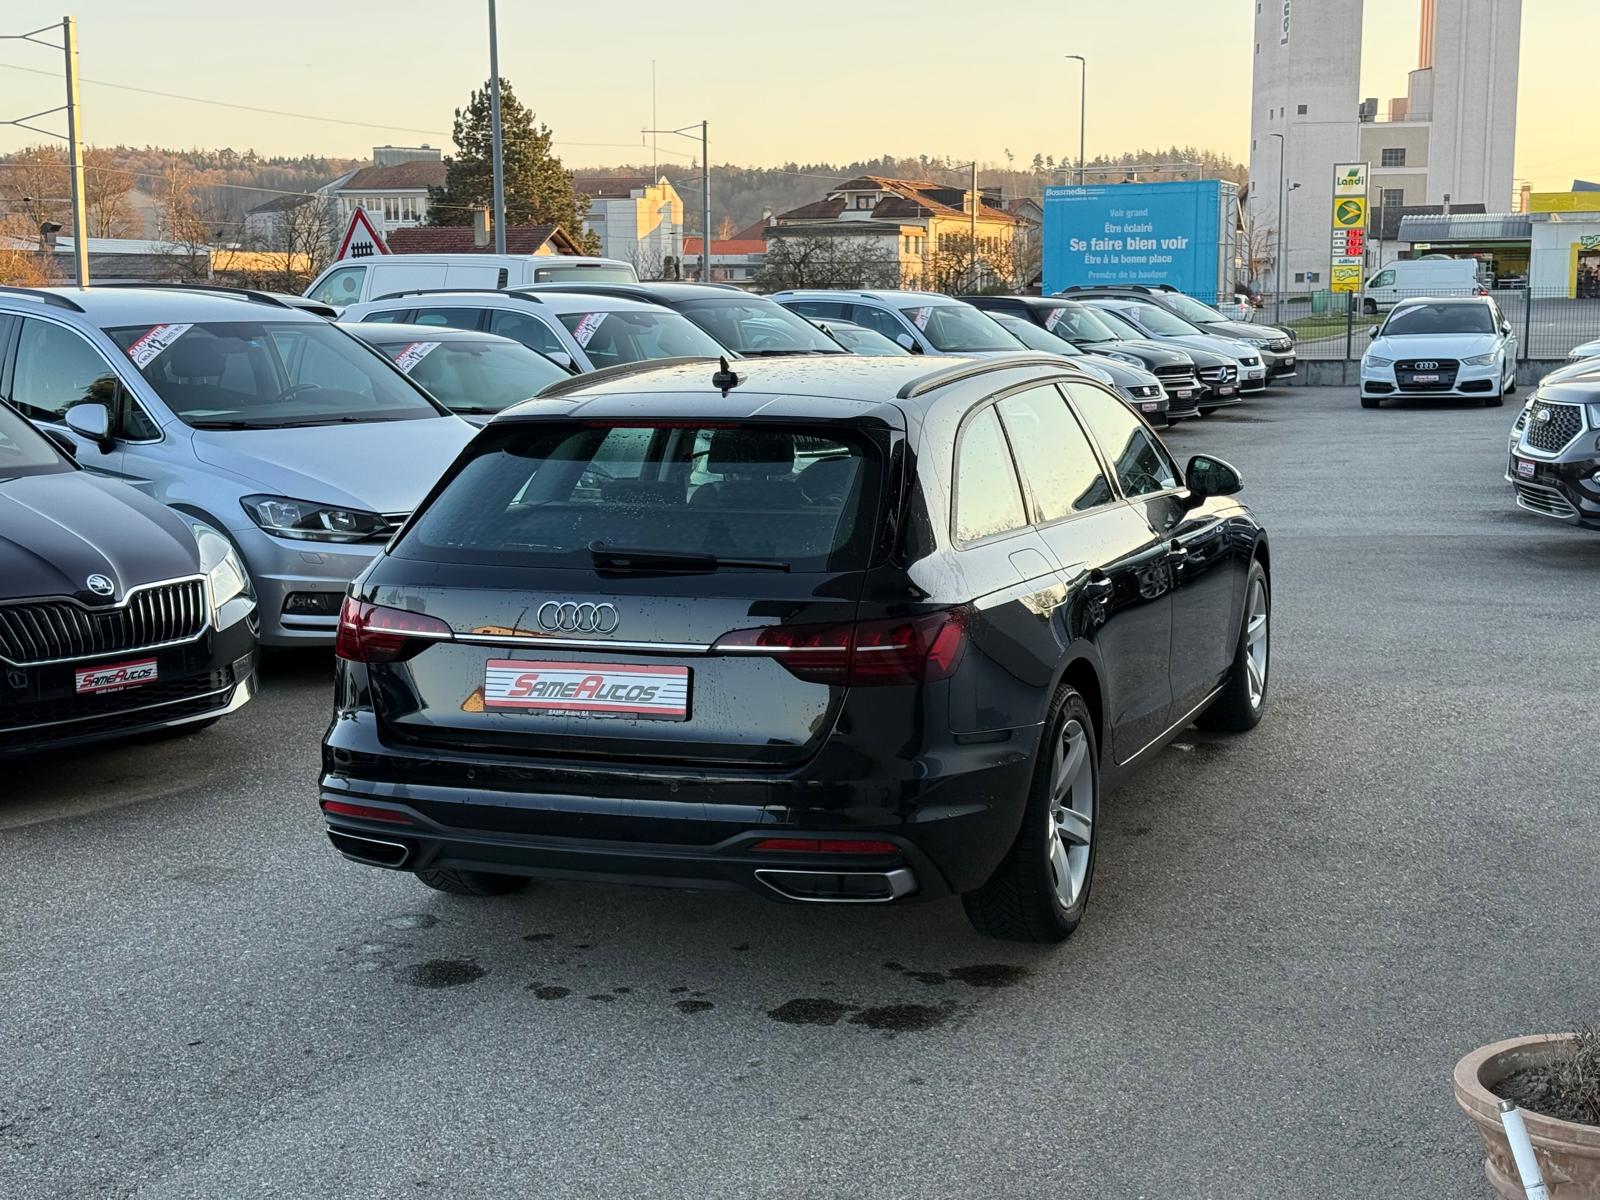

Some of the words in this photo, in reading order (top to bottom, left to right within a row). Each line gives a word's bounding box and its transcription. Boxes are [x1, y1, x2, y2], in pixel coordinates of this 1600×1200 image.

[1281, 0, 1290, 45] Lan
[1336, 176, 1364, 186] Landi
[1109, 209, 1124, 217] Voir
[1126, 208, 1148, 218] grand
[1104, 222, 1121, 233] Être
[1124, 222, 1152, 233] éclairé
[1069, 238, 1087, 251] Se
[1091, 237, 1123, 251] faire
[1127, 237, 1157, 250] bien
[1161, 235, 1188, 249] voir
[1085, 253, 1102, 264] Être
[1103, 254, 1109, 264] à
[1111, 254, 1119, 264] la
[1121, 254, 1147, 264] bonne
[1149, 253, 1173, 264] place
[1088, 270, 1117, 279] Prendre
[1118, 270, 1128, 279] de
[1129, 269, 1137, 279] la
[147, 339, 168, 351] 12
